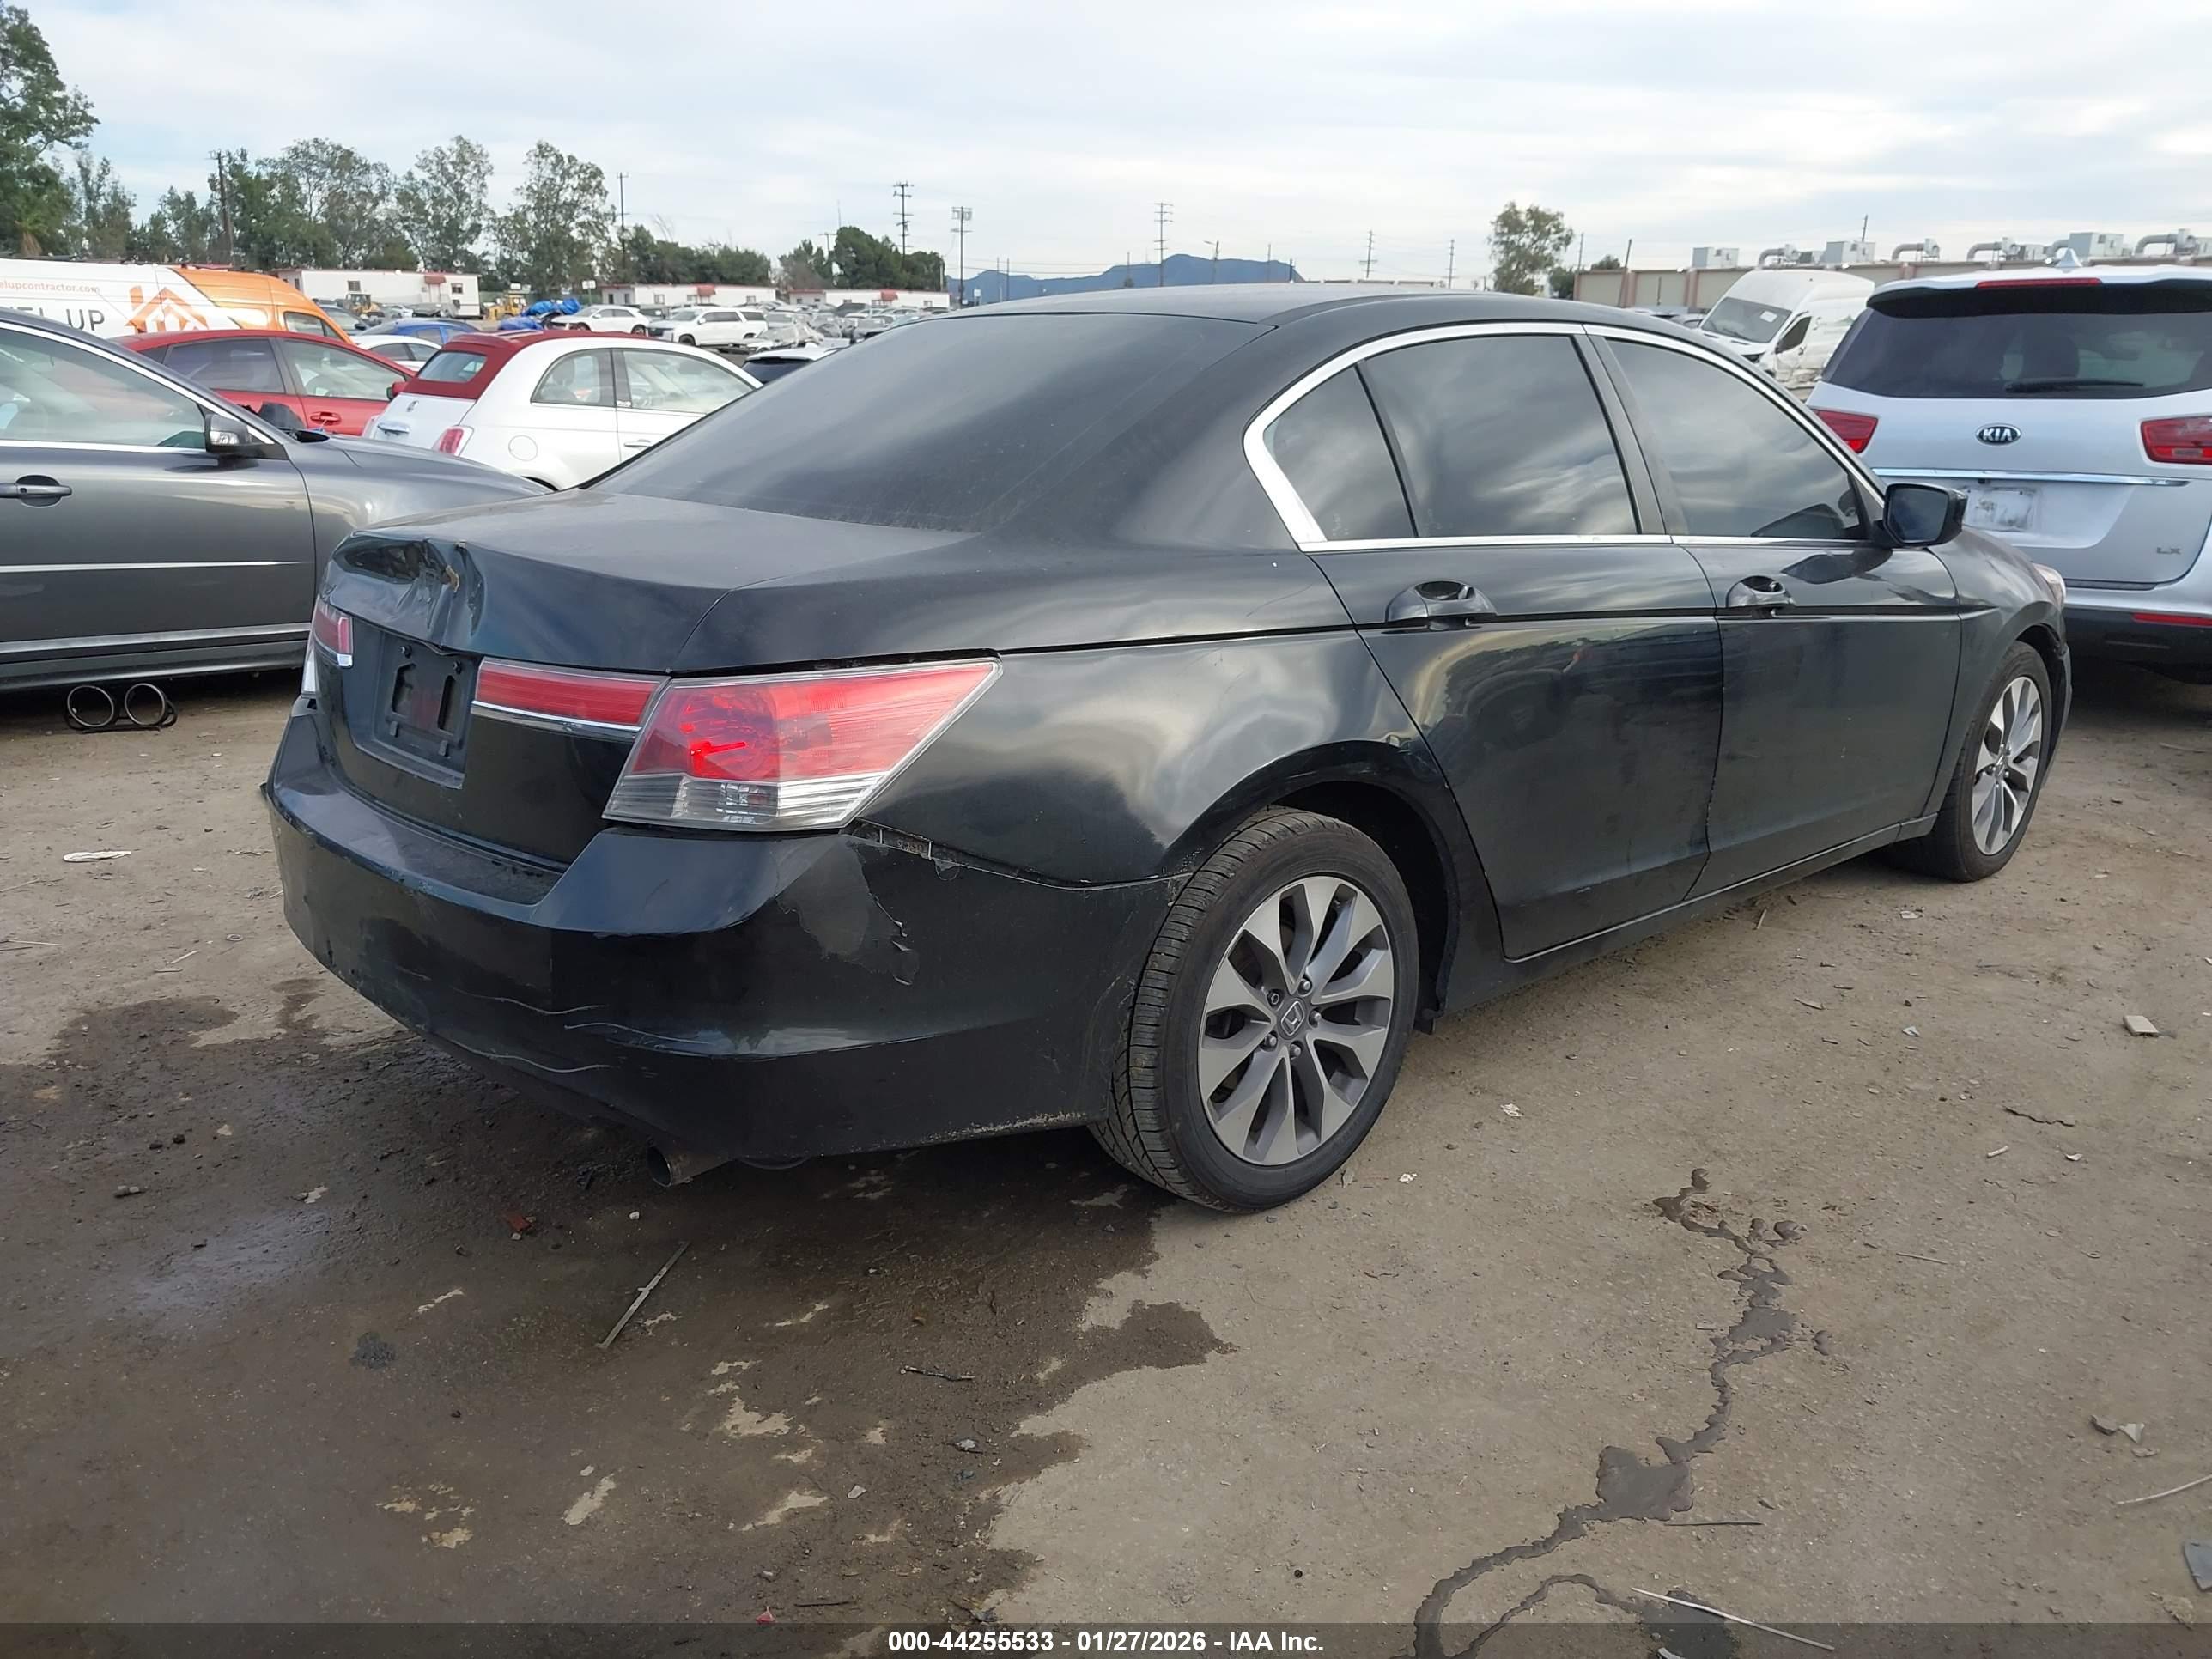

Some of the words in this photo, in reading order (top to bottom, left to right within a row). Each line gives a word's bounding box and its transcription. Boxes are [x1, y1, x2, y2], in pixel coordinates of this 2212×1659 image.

[65, 308, 105, 331] UP
[1982, 428, 2013, 441] KIA
[2156, 546, 2182, 556] LX
